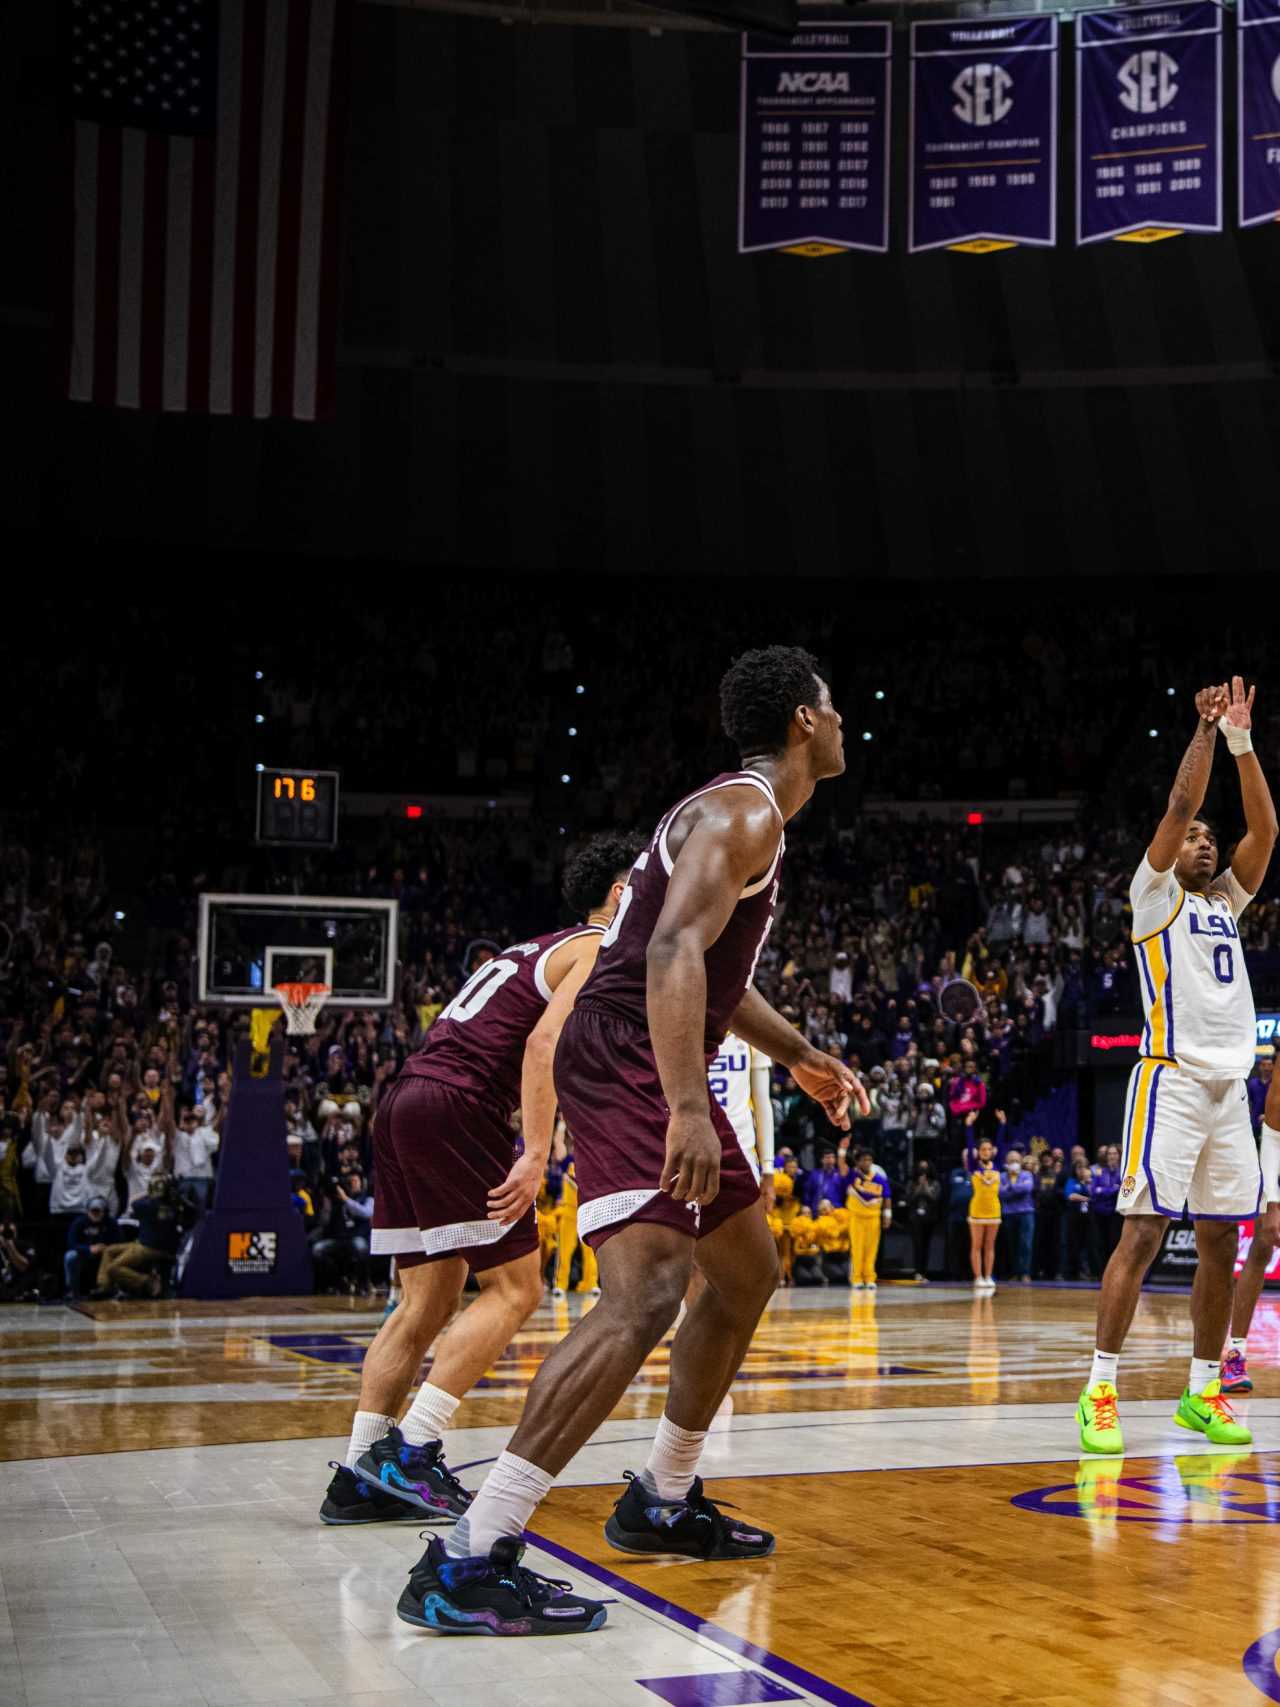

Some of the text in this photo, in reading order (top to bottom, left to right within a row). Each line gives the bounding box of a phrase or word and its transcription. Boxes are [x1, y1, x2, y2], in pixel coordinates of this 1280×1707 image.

[777, 72, 850, 93] NCAA
[951, 62, 1014, 127] SEC
[1117, 49, 1180, 114] SEC
[1110, 120, 1187, 141] CHAMPIONS
[1189, 912, 1237, 938] LSU
[1213, 944, 1233, 983] 0
